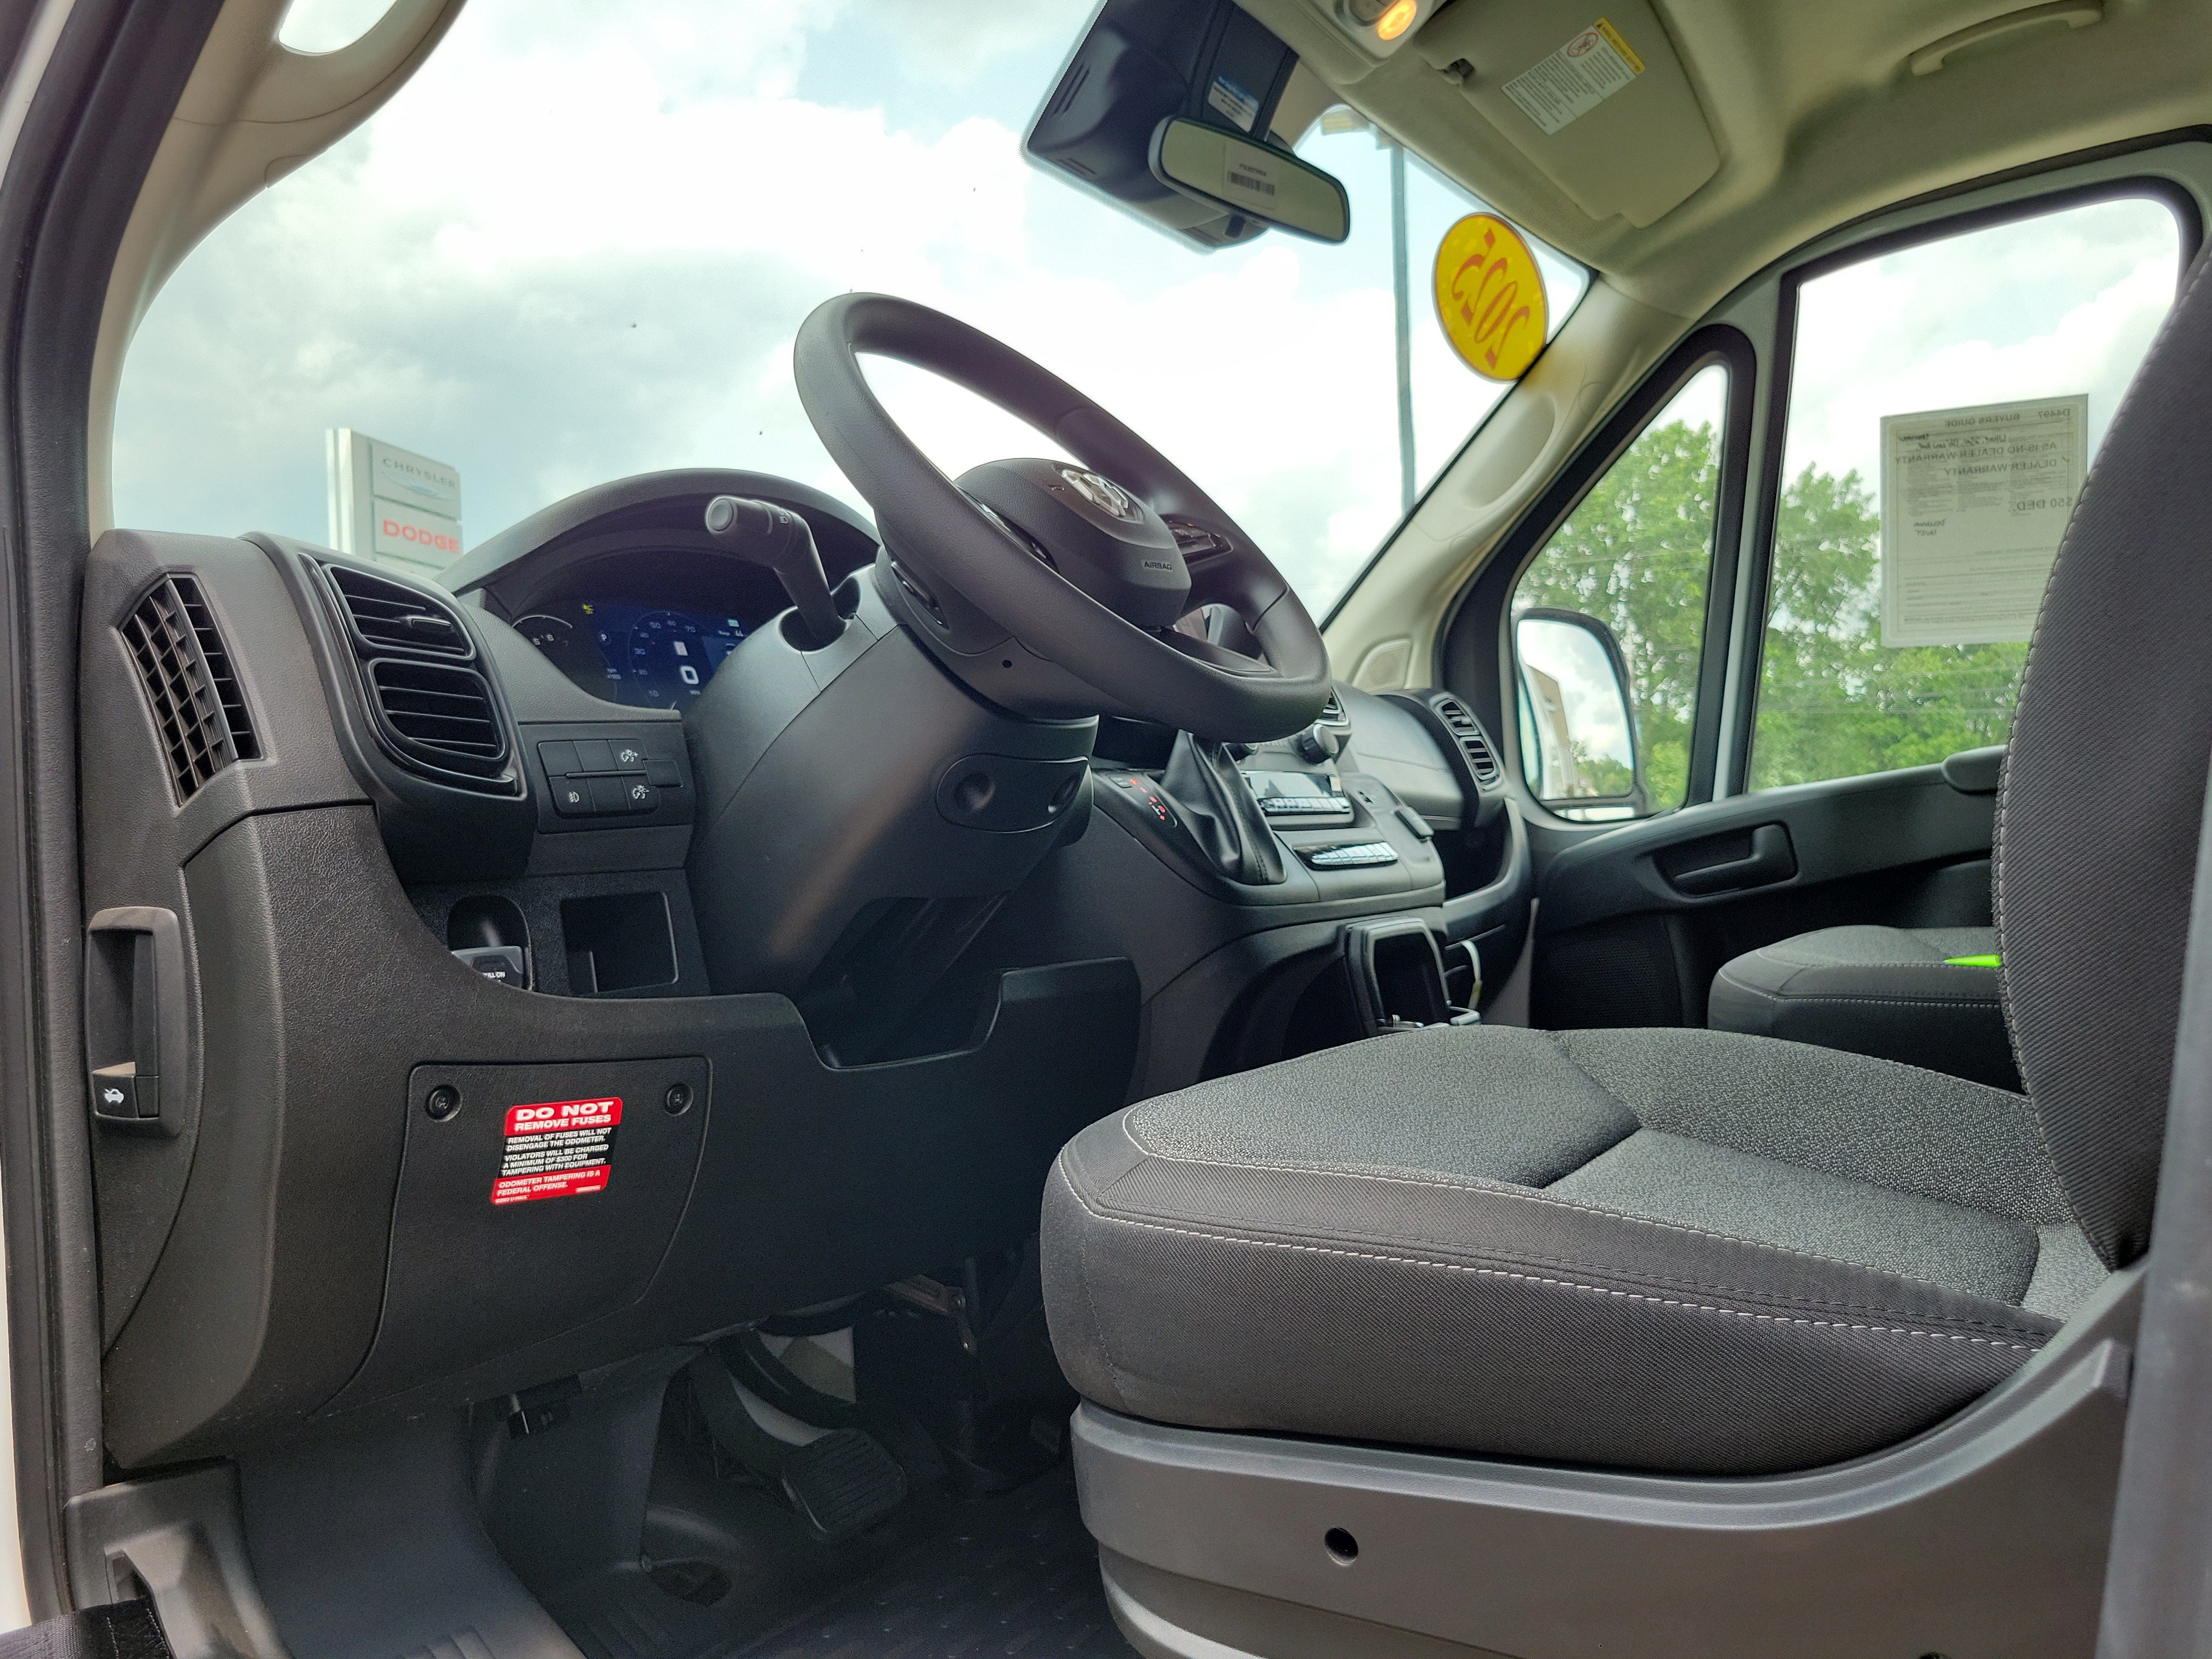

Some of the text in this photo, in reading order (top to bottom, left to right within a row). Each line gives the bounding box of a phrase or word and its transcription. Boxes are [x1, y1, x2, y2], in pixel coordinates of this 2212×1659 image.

[383, 458, 455, 487] CHRYSLER
[383, 520, 460, 555] DODGE
[1144, 561, 1172, 571] AIRBAG
[680, 665, 699, 685] 0
[516, 1101, 614, 1121] DO NOT
[515, 1114, 611, 1132] REMOVE FUSES
[508, 1135, 543, 1144] REMOVAL
[555, 1131, 578, 1139] FUSES
[579, 1129, 596, 1137] WILL
[504, 1152, 545, 1162] VIOLATORS
[575, 1144, 609, 1153] CHARGED
[507, 1141, 549, 1152] DISENGAGE
[501, 1158, 606, 1177] TAMPERING WITH EQUIPMENT.
[510, 1158, 545, 1169] MINIMUM
[498, 1177, 543, 1189] ODOMETER
[543, 1171, 586, 1183] TAMPERING
[594, 1169, 601, 1177] A
[497, 1186, 532, 1197] FEDERAL
[532, 1181, 568, 1192] OFFENSE.
